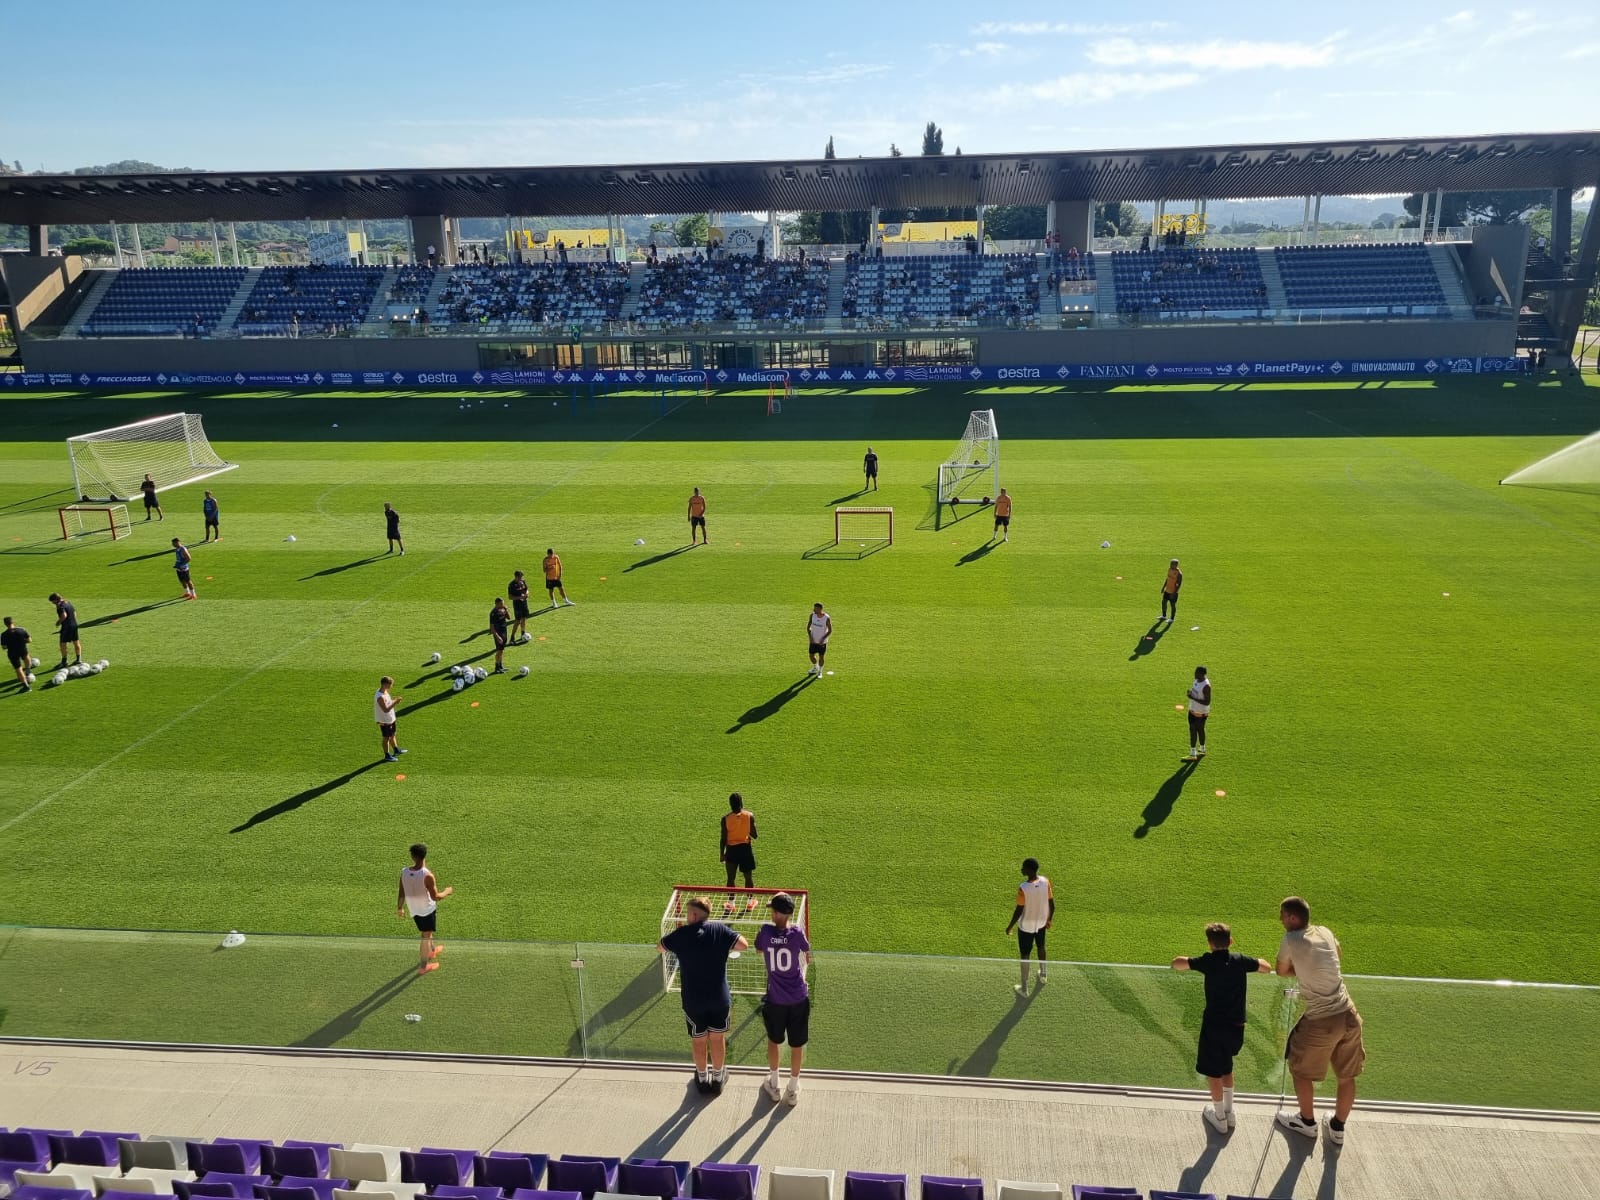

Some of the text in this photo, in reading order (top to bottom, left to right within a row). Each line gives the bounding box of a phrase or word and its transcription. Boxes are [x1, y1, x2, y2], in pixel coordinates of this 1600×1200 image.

[1080, 365, 1135, 376] FANFANI
[1359, 362, 1415, 372] NUOVACOMAUTO
[738, 372, 785, 382] Mediacom
[768, 947, 792, 972] 10
[14, 1060, 59, 1076] V5
